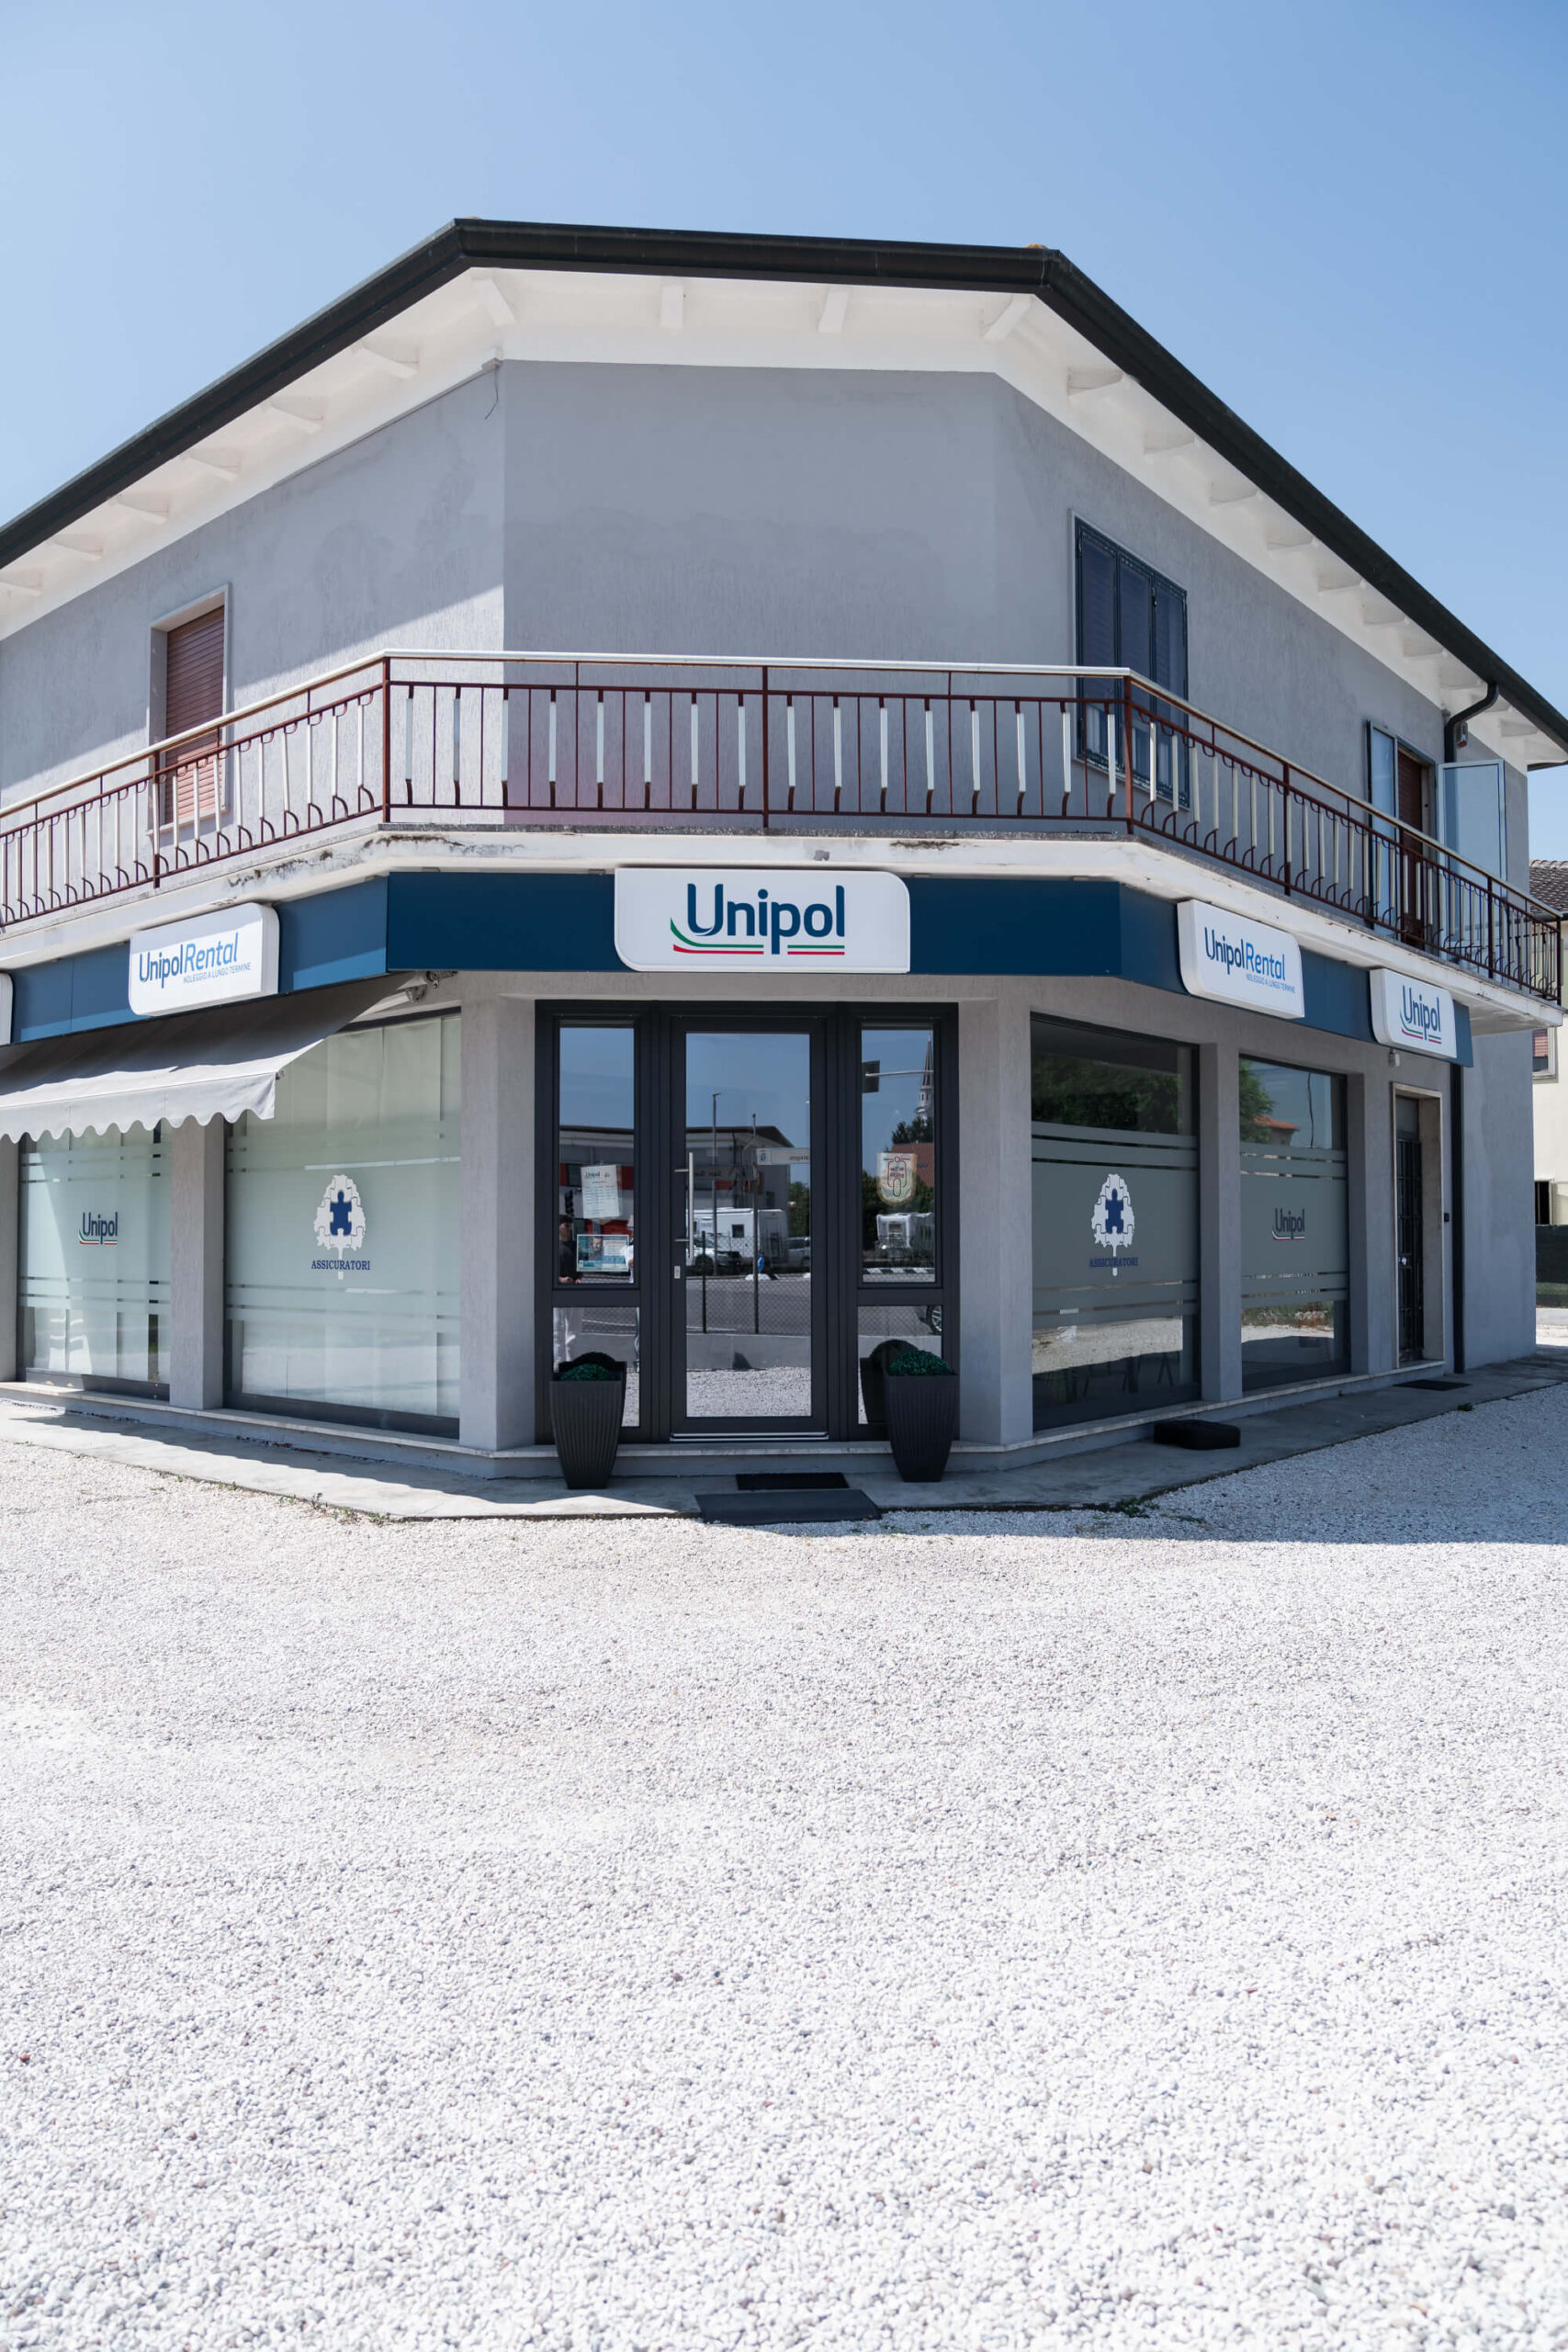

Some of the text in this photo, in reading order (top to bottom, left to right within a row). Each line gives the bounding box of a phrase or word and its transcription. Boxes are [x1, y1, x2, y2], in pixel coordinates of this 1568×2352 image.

[687, 883, 845, 955] Unipol
[139, 932, 239, 989] UnipolRental
[1204, 926, 1286, 981] UnipolRental
[184, 971, 208, 985] NOLEGGIO
[212, 967, 230, 979] LUNGO
[230, 962, 252, 975] TERMINE
[1402, 984, 1441, 1041] Unipol
[83, 1211, 118, 1245] Unipol
[1274, 1207, 1305, 1240] Unipol
[311, 1260, 371, 1271] ASSICURATORI
[1089, 1257, 1138, 1267] ASSICURATORI
